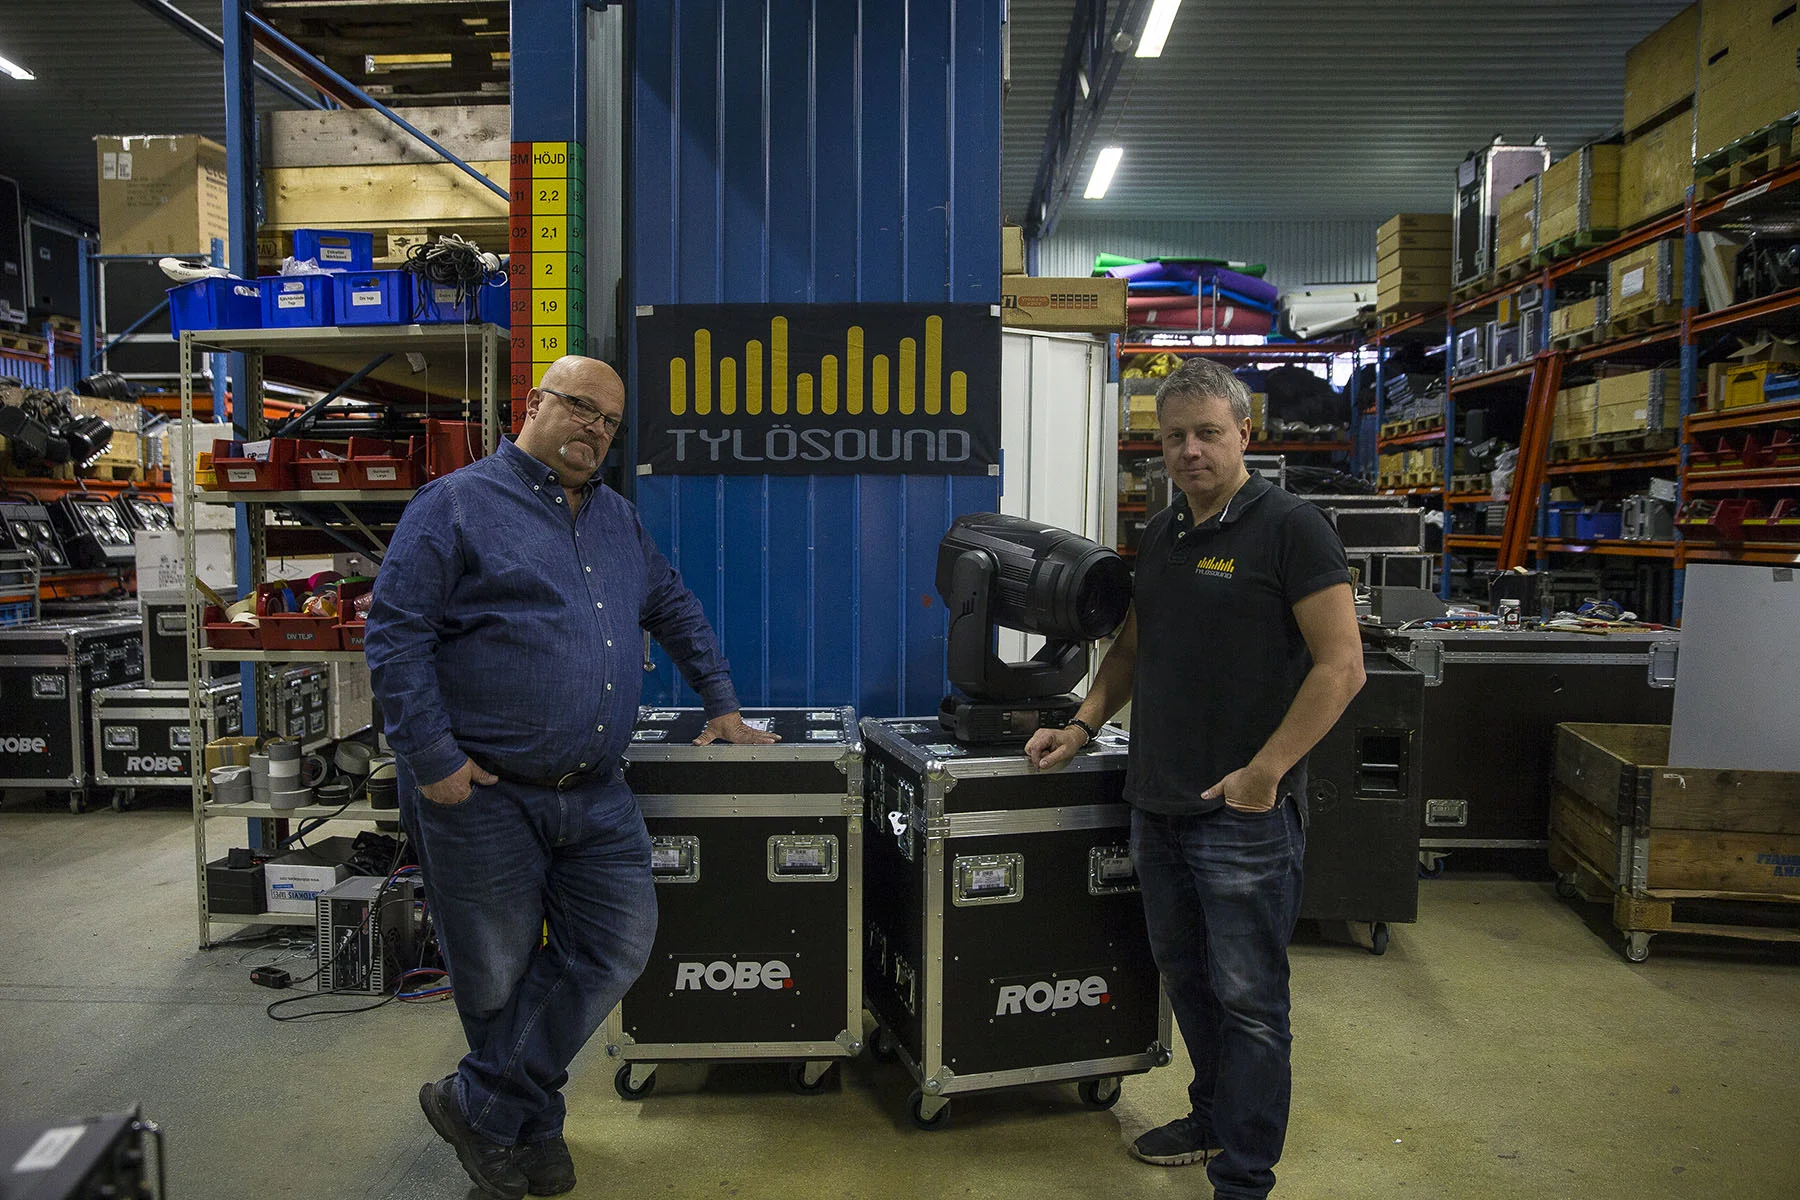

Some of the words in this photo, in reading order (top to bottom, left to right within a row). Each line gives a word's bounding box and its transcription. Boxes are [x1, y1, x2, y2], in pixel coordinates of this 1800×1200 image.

[533, 151, 566, 165] HÖJD
[539, 190, 559, 203] 2,2
[541, 227, 557, 240] 2,1
[545, 264, 553, 275] 2
[540, 301, 558, 313] 1,9
[540, 338, 558, 350] 1,8
[666, 423, 970, 461] TYLÖSOUND
